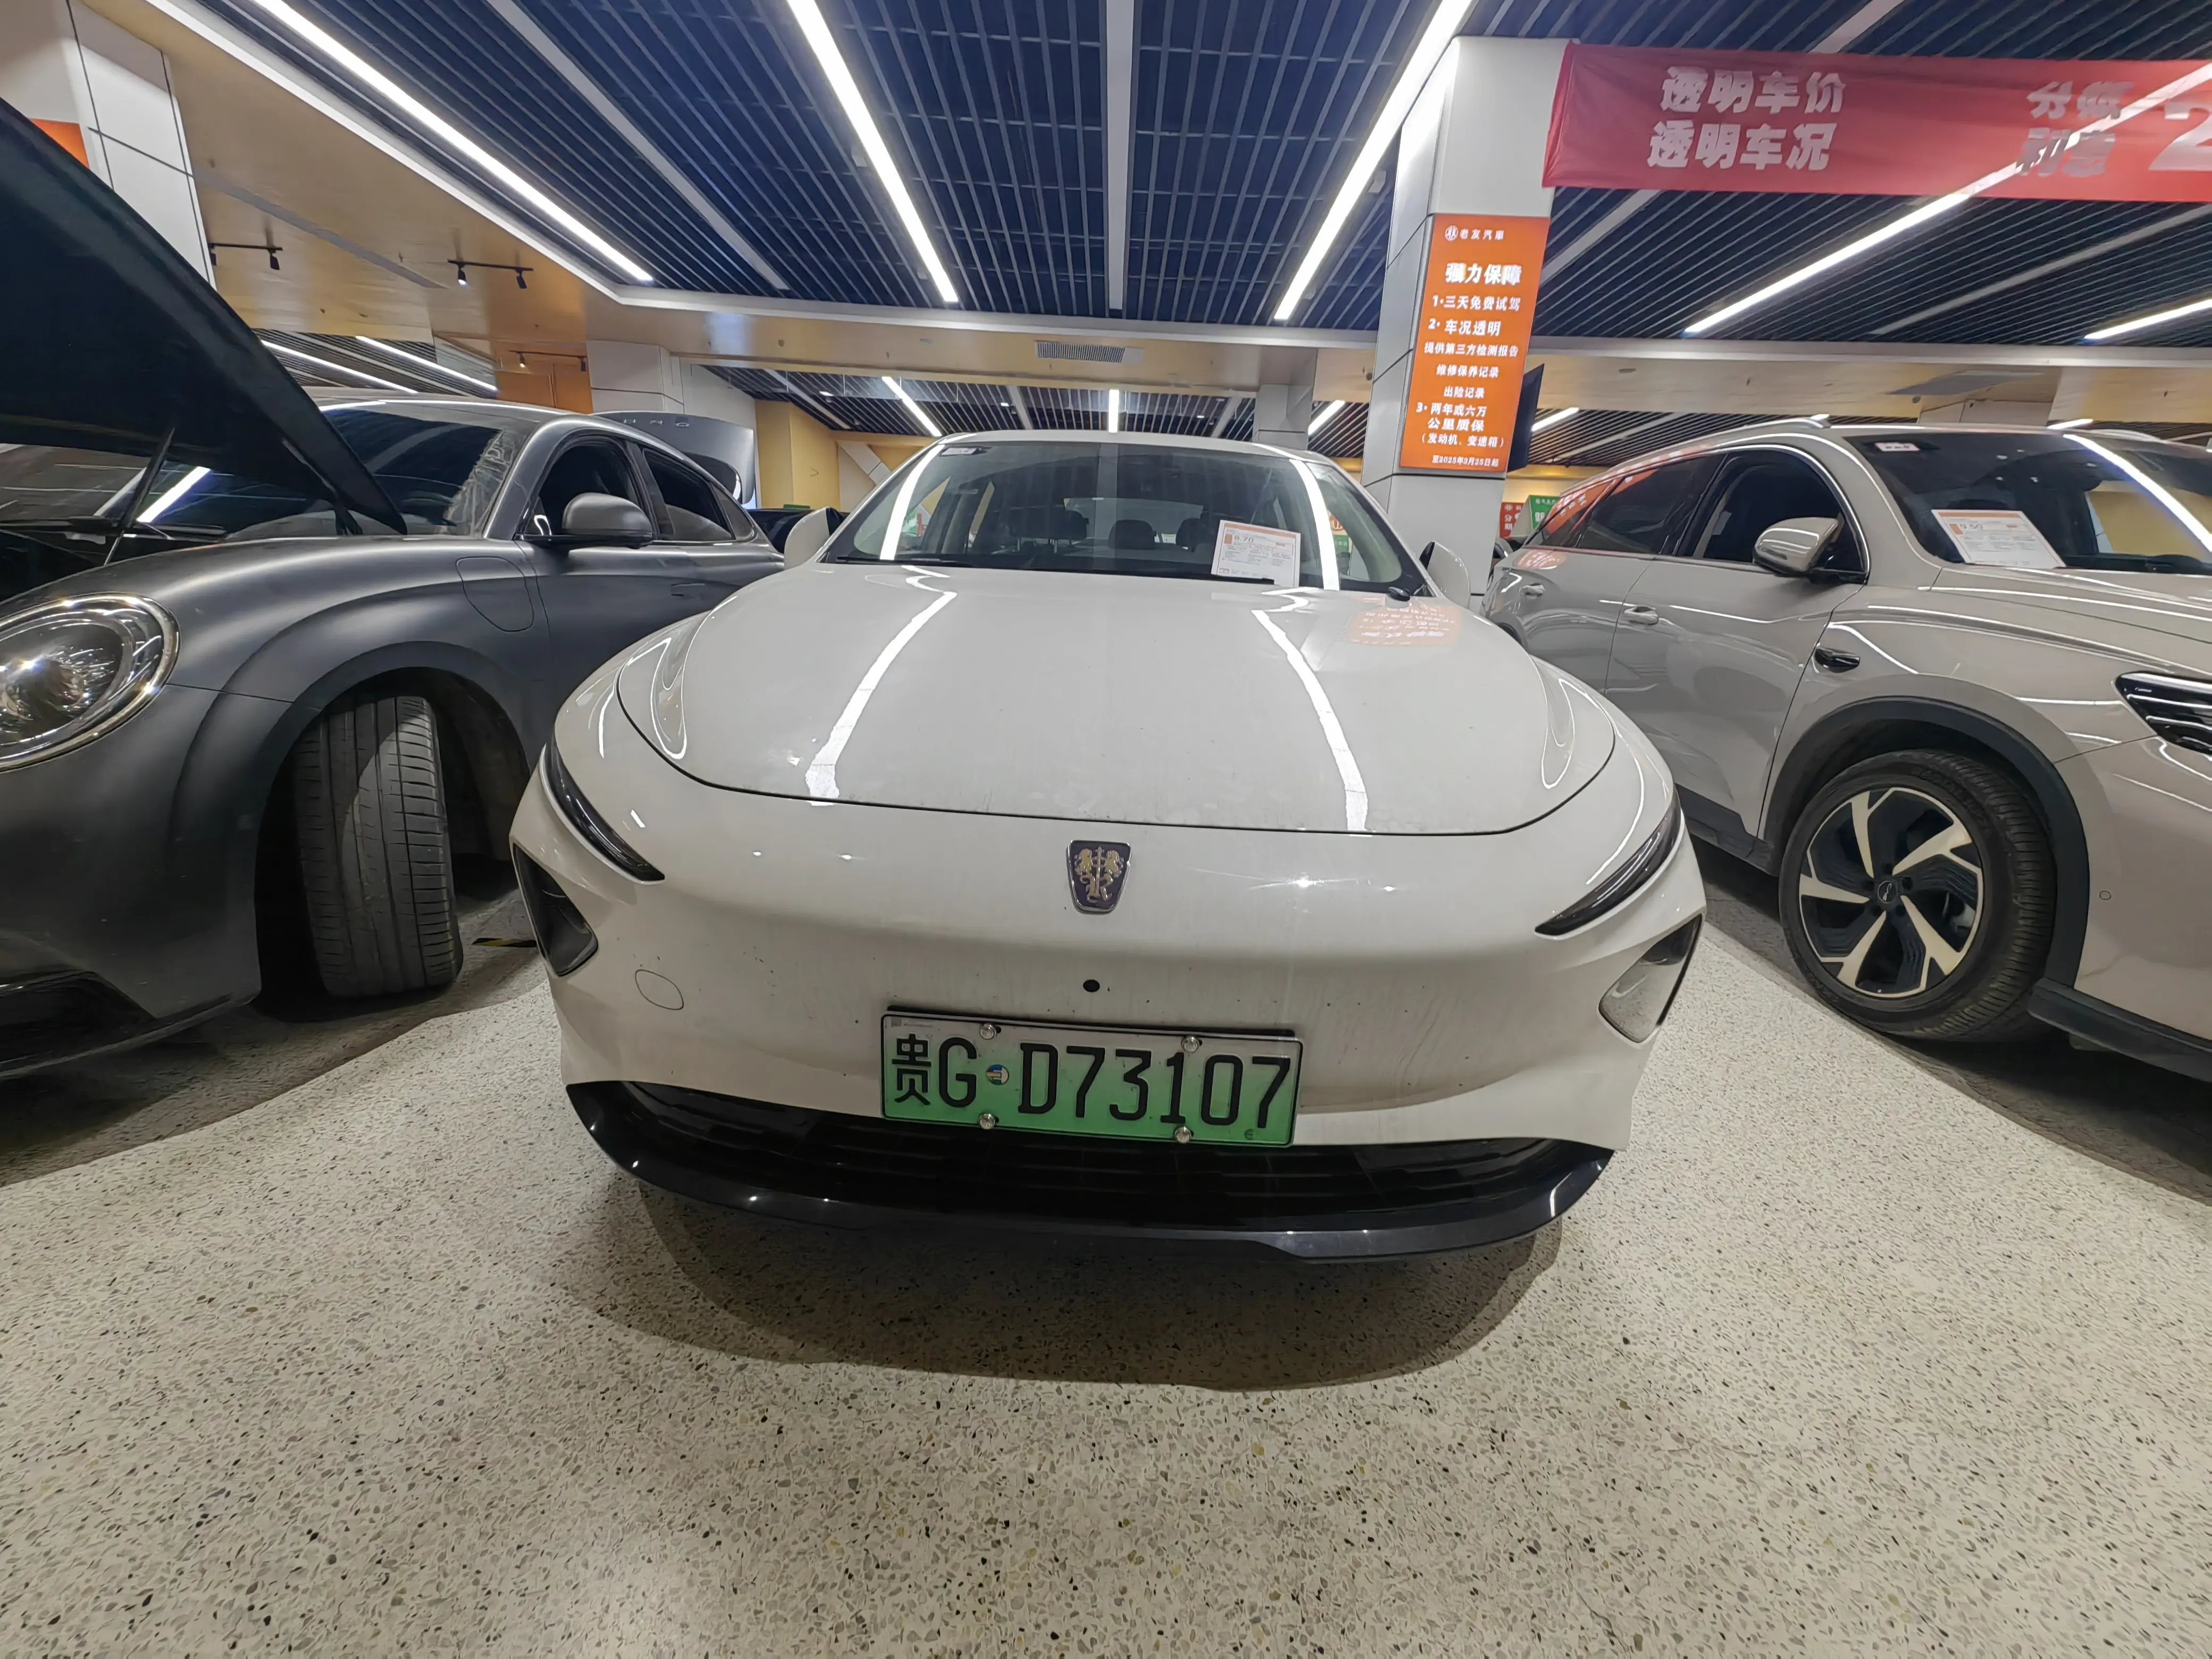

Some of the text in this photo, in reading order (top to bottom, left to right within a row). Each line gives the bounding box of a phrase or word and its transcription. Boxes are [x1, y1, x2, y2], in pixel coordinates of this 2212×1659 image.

[1660, 66, 1846, 114] 透明车价
[1647, 120, 1837, 170] 透明车况
[1445, 263, 1522, 286] 强力保障
[1424, 341, 1519, 357] 提供第三方检测报告
[1436, 364, 1499, 378] 维修保养记录
[1444, 386, 1485, 398] 出险记录
[1427, 417, 1484, 432] 公里质保
